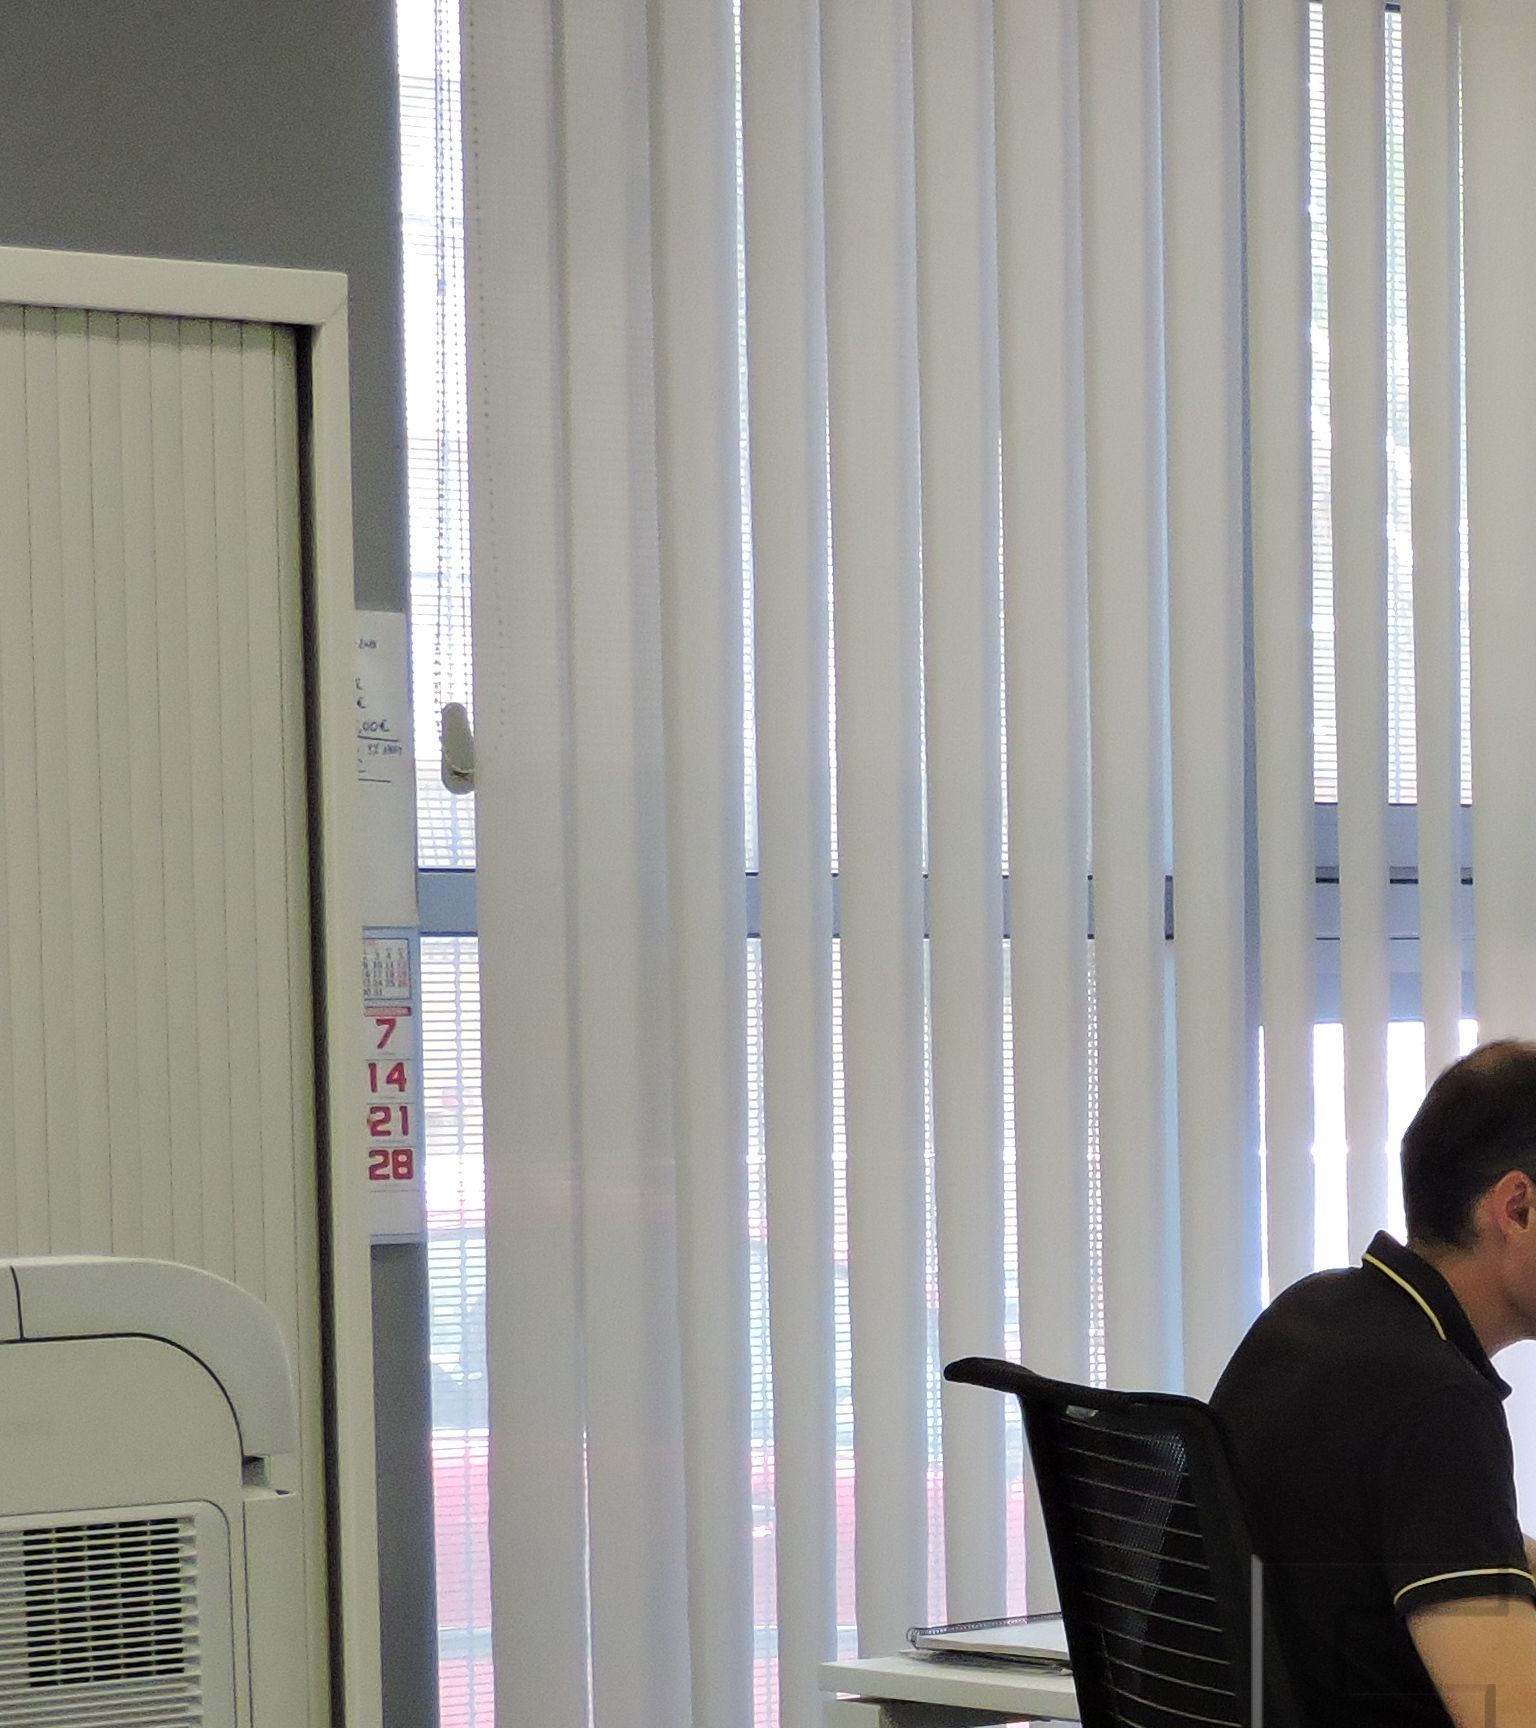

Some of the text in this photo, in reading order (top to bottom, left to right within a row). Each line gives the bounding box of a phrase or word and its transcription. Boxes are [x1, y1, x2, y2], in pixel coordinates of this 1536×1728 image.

[376, 1018, 397, 1049] 7
[368, 1062, 407, 1093] 14
[369, 1106, 409, 1136] 21
[368, 1148, 413, 1181] 28
